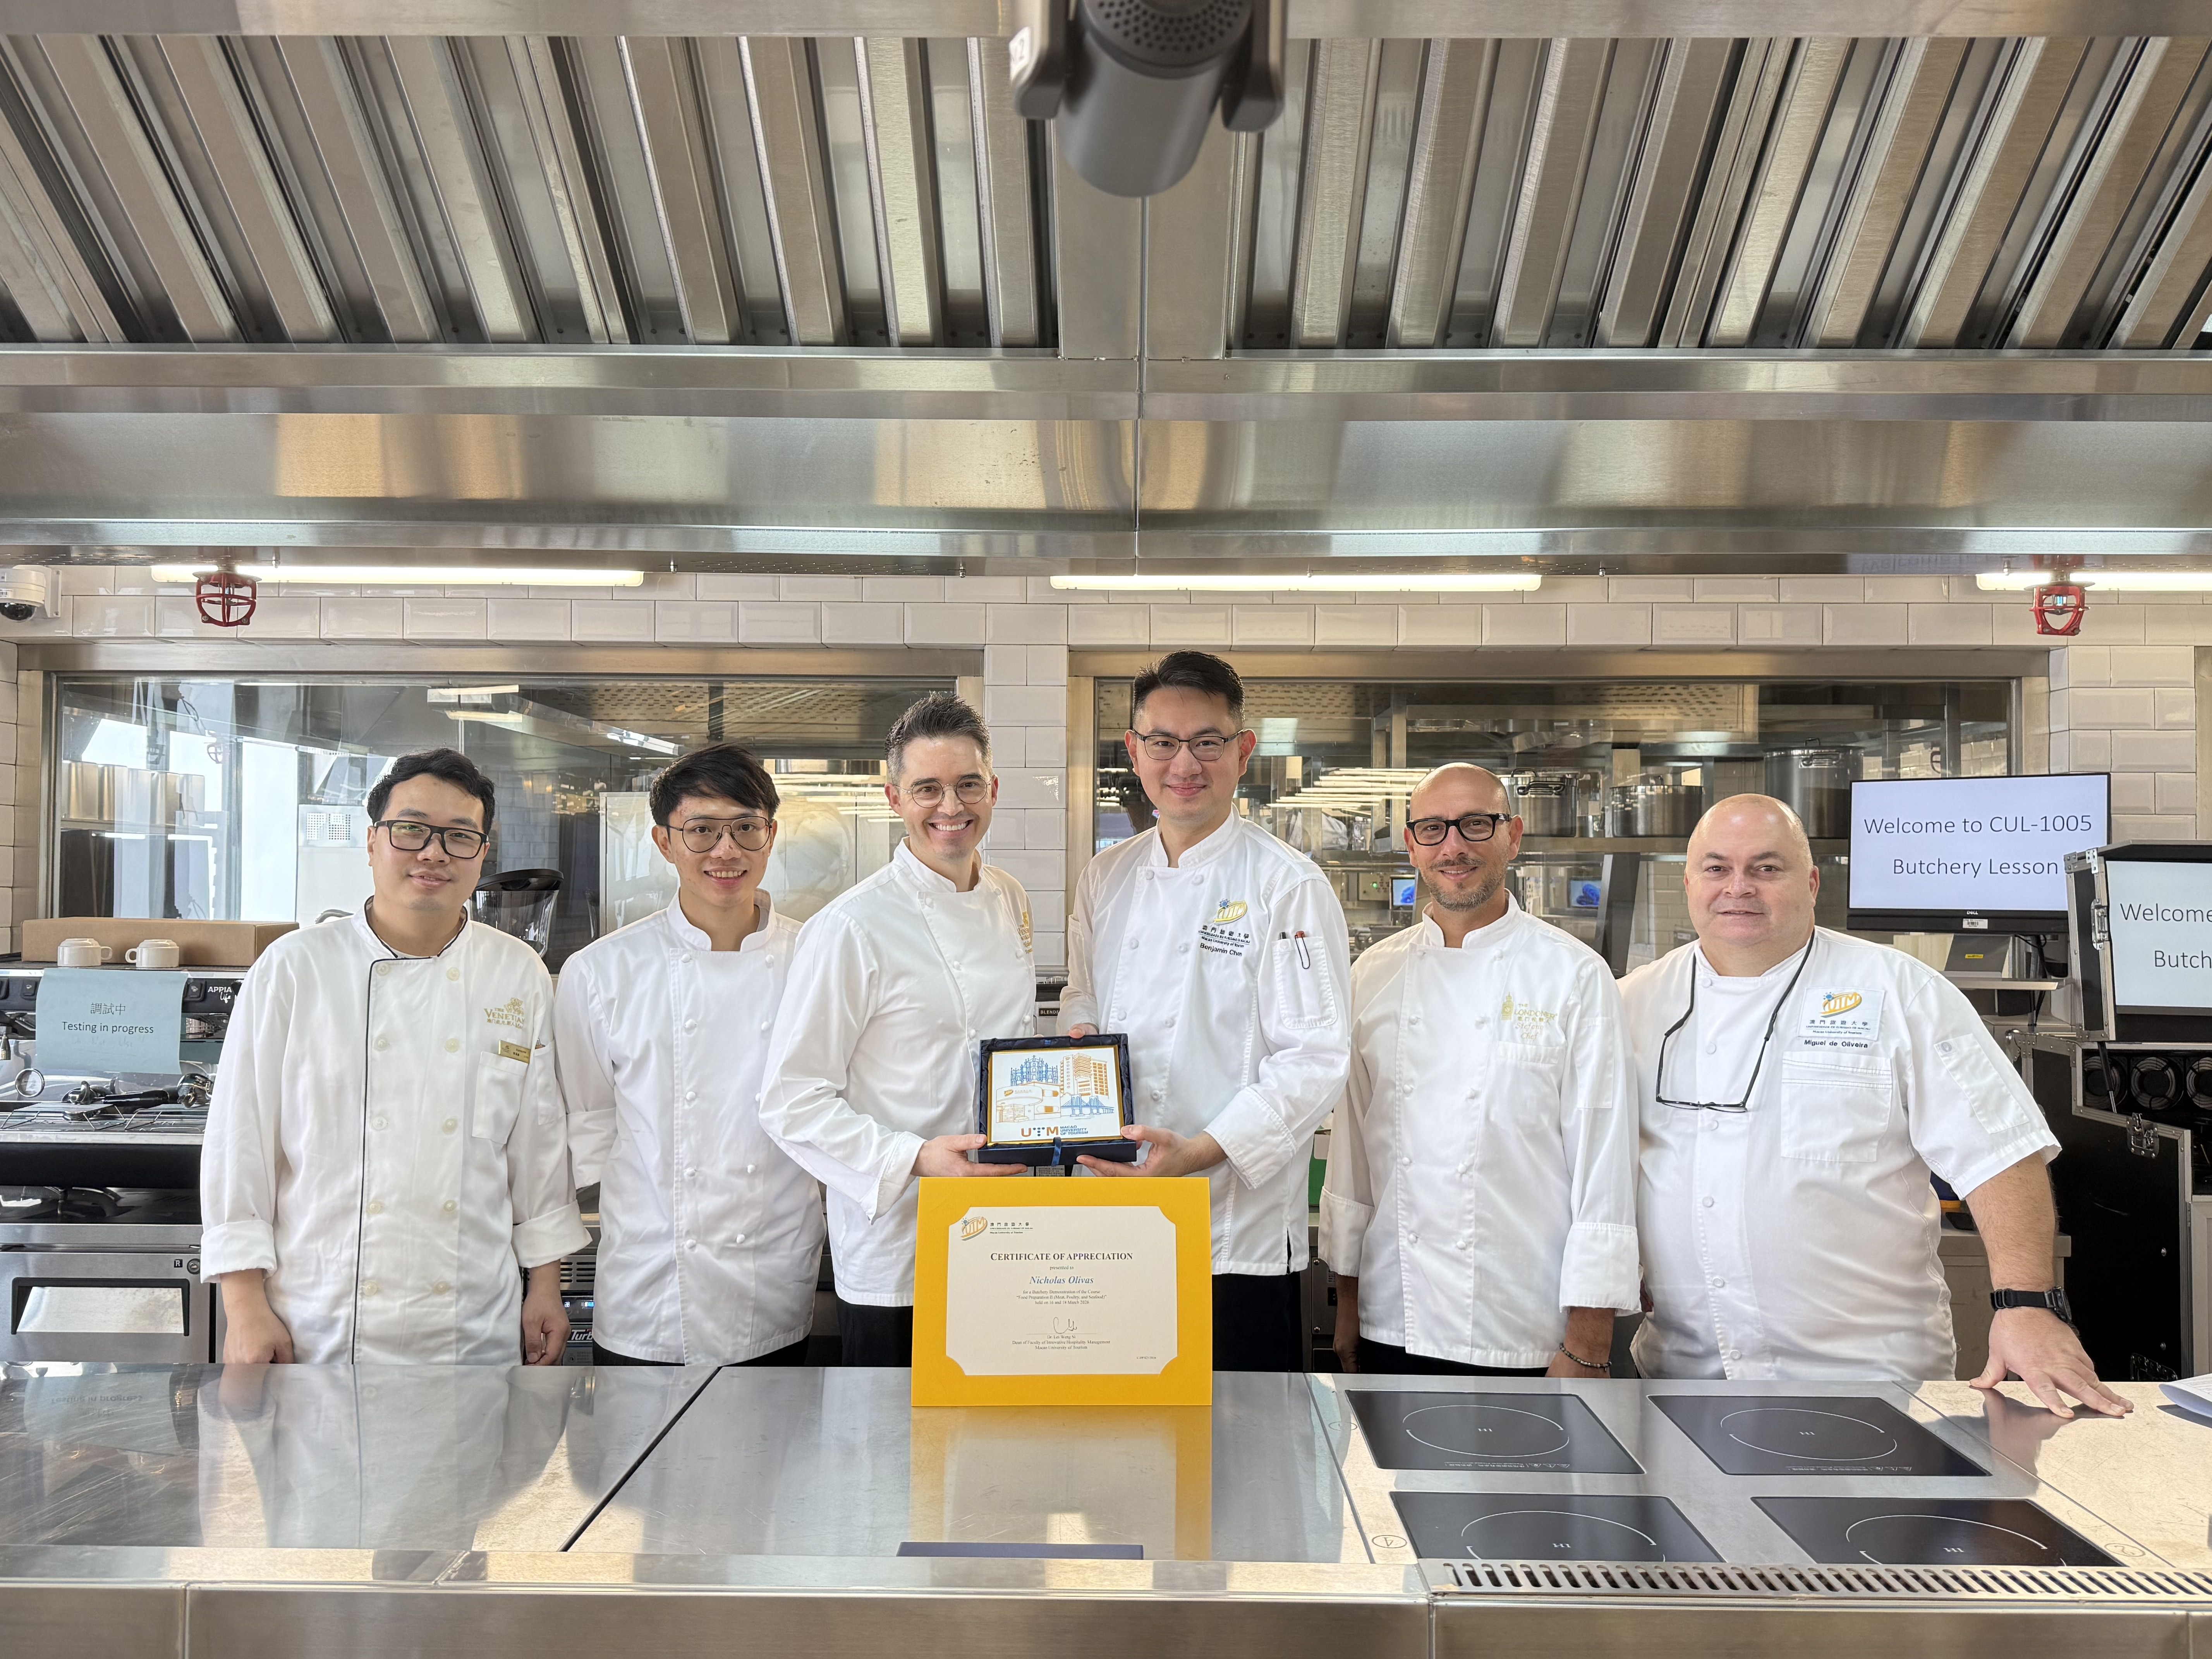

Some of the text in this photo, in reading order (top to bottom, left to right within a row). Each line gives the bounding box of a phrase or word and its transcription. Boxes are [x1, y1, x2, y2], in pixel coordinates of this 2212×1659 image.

[1864, 814, 2092, 834] Welcome to CUL-1005
[1894, 858, 2058, 879] Butchery Lesson
[1200, 942, 1228, 954] Benjamin
[90, 1003, 126, 1015] 調試中
[62, 1021, 154, 1034] Testing in progress
[1021, 1126, 1059, 1137] UTM
[990, 1252, 1051, 1261] CERTIFICATE
[1029, 1276, 1094, 1284] Nicholas Olivas
